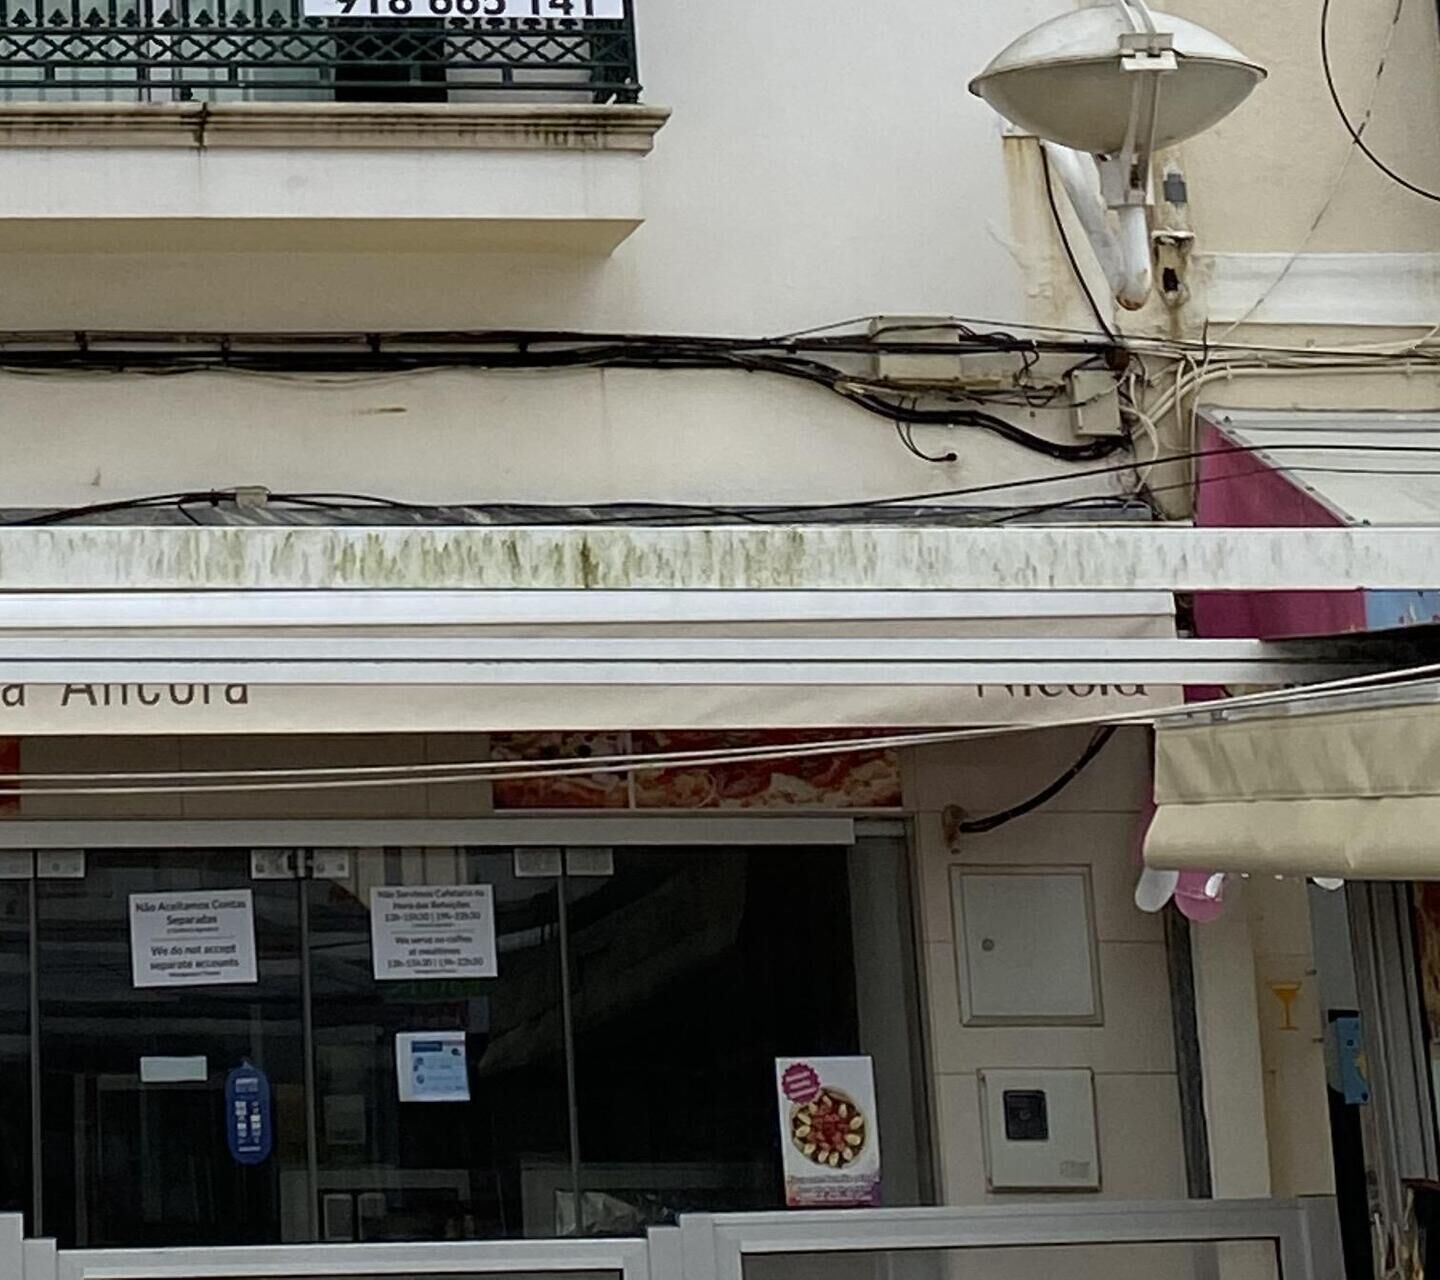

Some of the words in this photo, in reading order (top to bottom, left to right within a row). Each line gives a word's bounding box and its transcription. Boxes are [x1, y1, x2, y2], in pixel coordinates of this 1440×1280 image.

[135, 901, 156, 912] Não
[158, 901, 210, 911] Aceitamos
[211, 899, 247, 910] Contas
[151, 946, 169, 956] We
[170, 946, 182, 955] do
[184, 945, 201, 954] not
[203, 944, 237, 955] accept
[150, 960, 193, 971] separate
[195, 958, 240, 969] accounts
